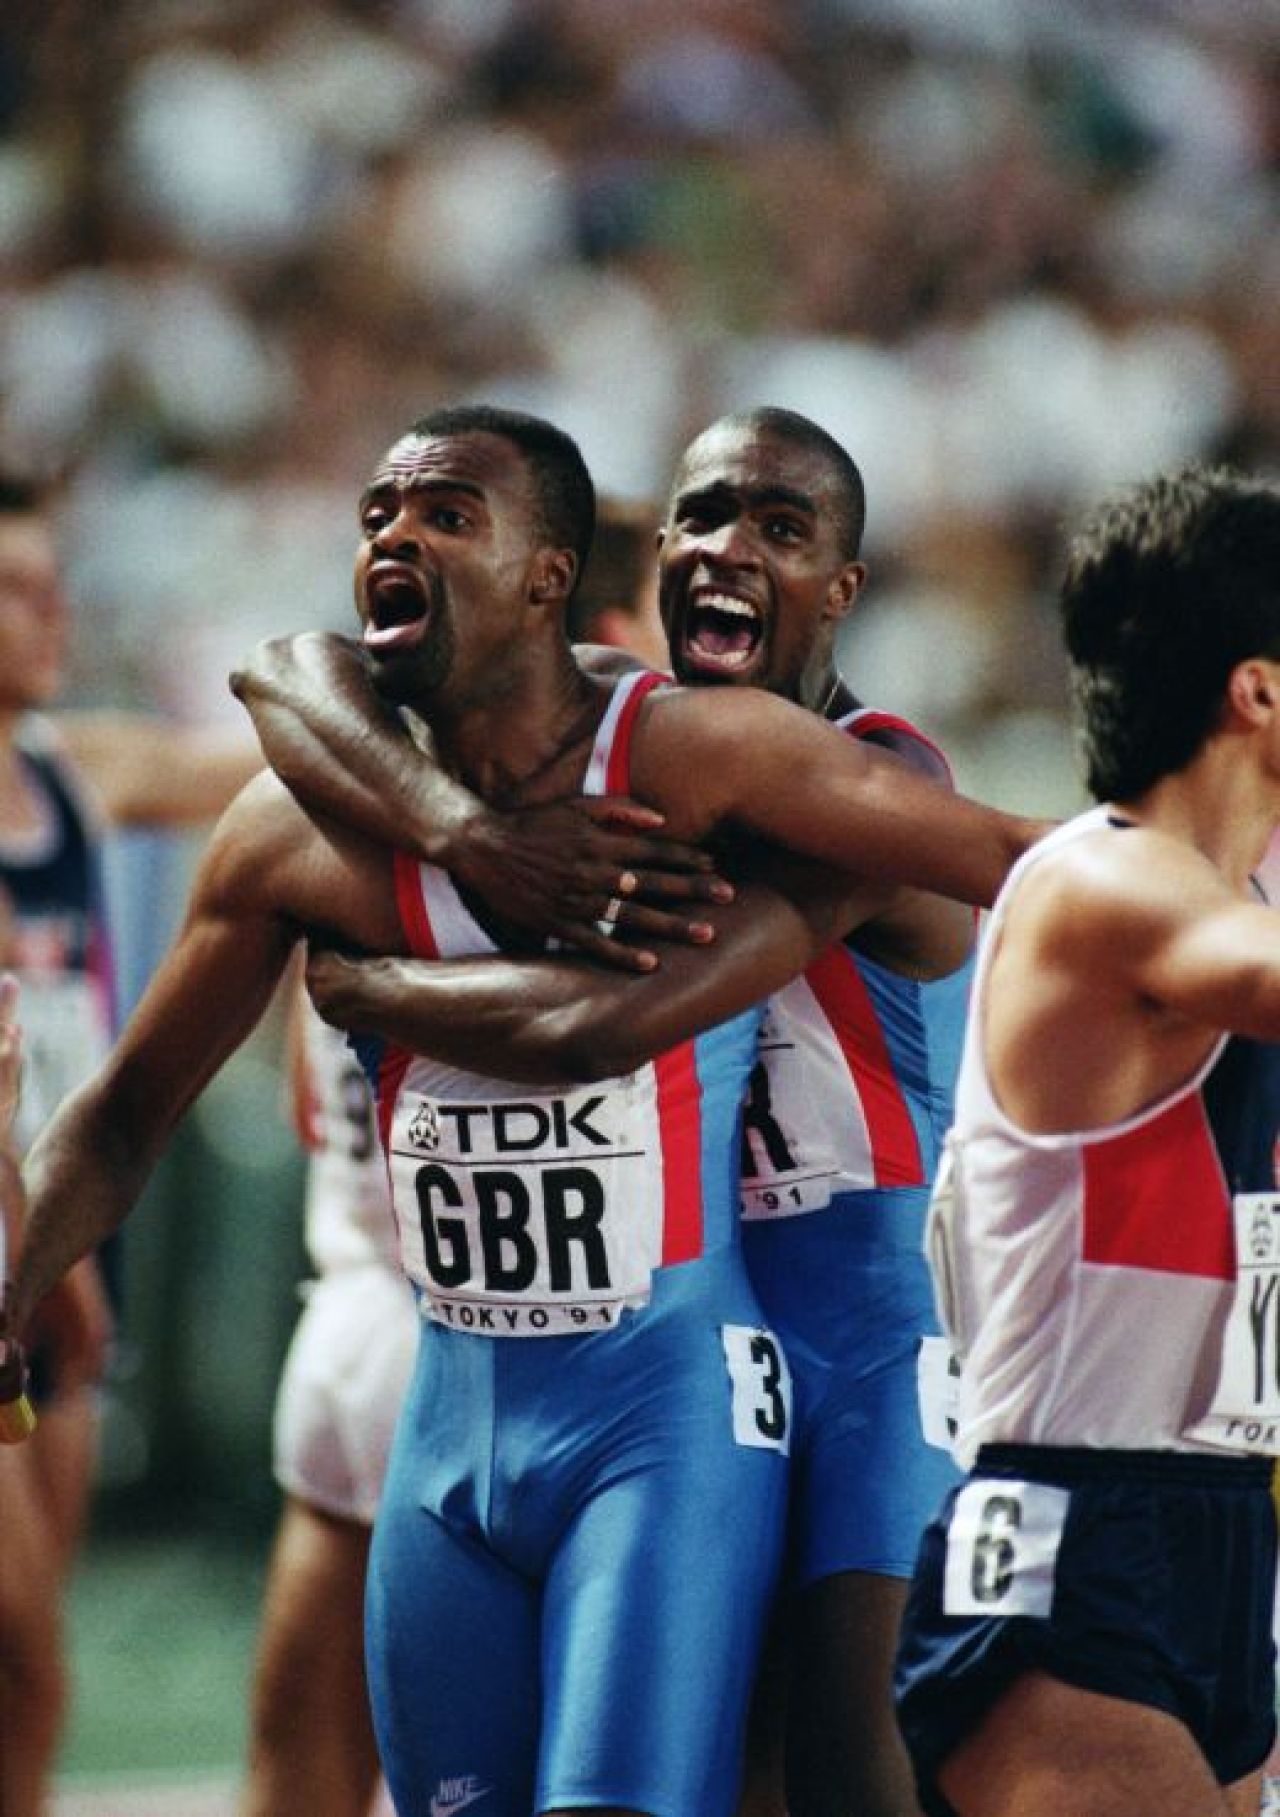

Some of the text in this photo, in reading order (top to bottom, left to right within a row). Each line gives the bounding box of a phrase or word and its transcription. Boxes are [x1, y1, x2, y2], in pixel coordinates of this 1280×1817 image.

[437, 1095, 613, 1153] TDK
[415, 1164, 612, 1293] GBR
[440, 1303, 550, 1329] TOKYO
[1250, 1273, 1280, 1404] Y
[749, 1335, 787, 1441] 3
[972, 1494, 1023, 1604] 6
